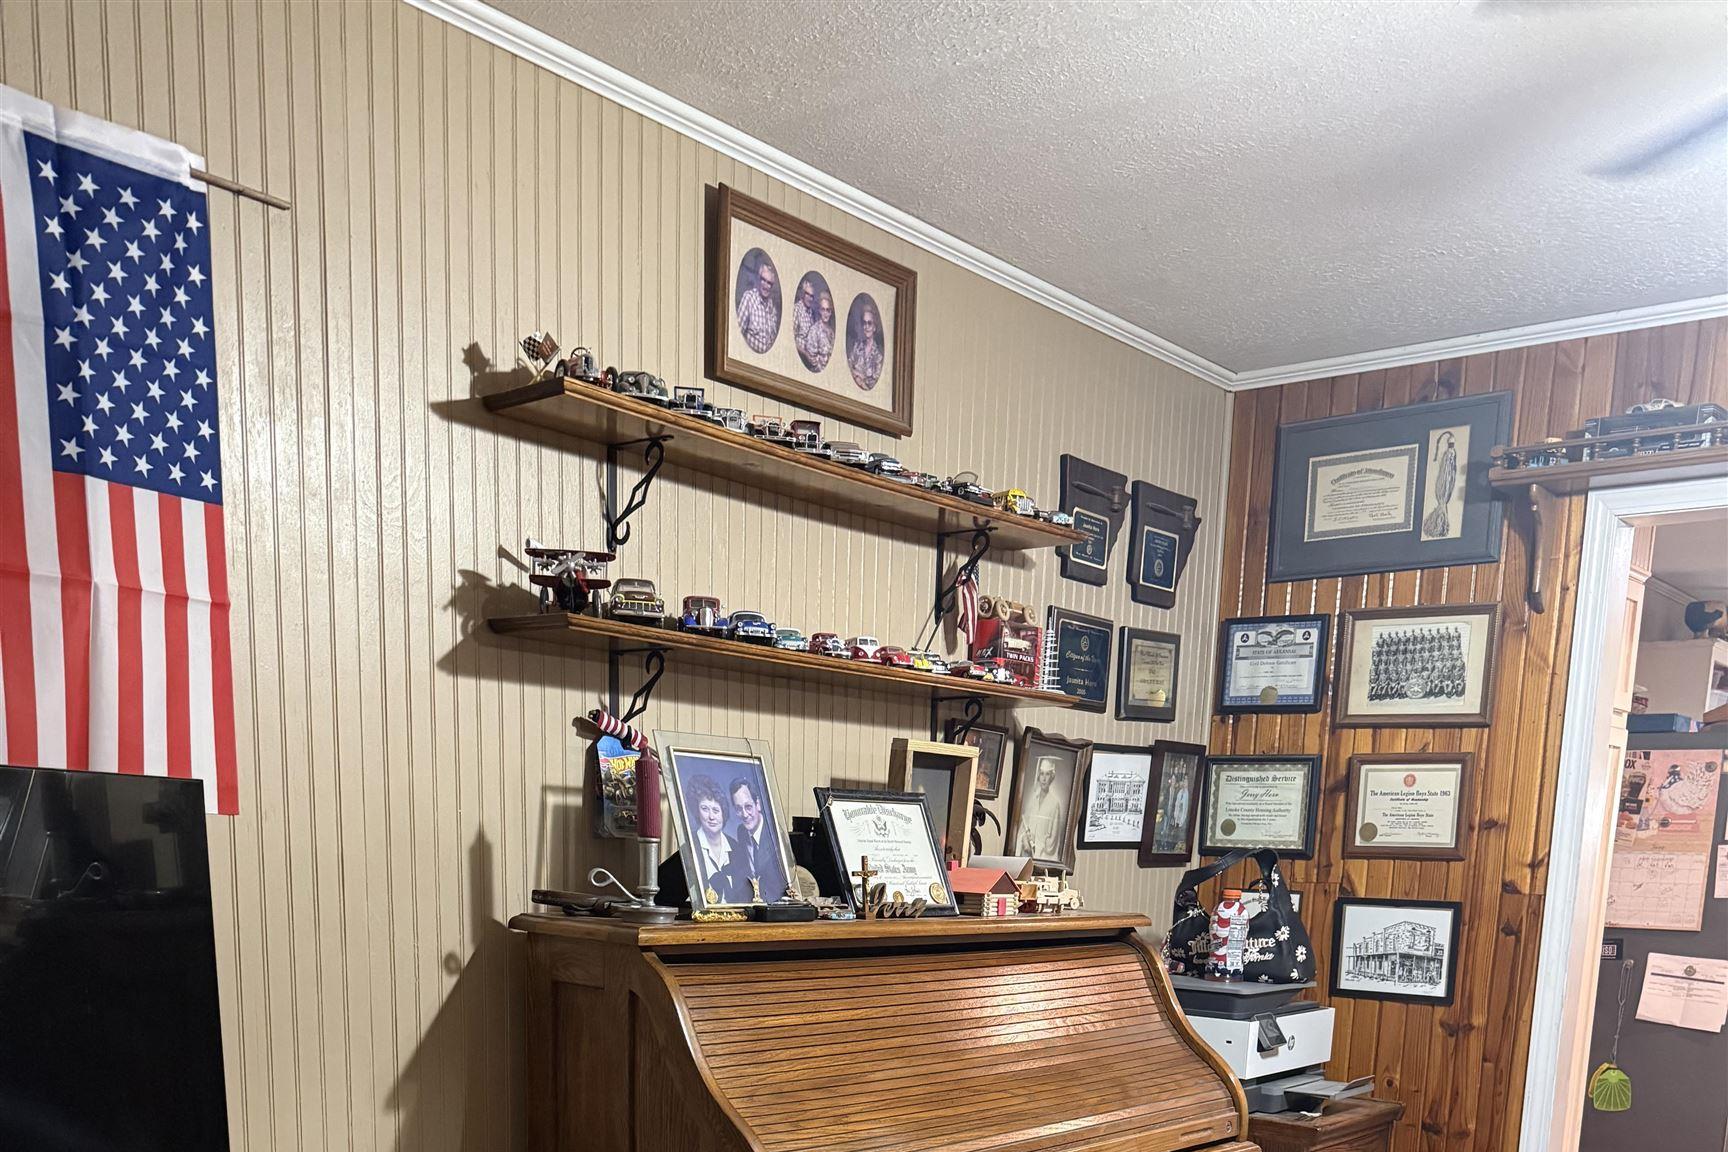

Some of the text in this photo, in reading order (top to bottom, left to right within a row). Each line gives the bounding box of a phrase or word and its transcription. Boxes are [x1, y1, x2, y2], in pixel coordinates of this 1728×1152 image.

[1006, 652, 1034, 663] TWIN PACKS
[1225, 774, 1297, 783] Distinguished Service
[1416, 790, 1427, 798] Boys
[868, 882, 928, 918] Jerry
